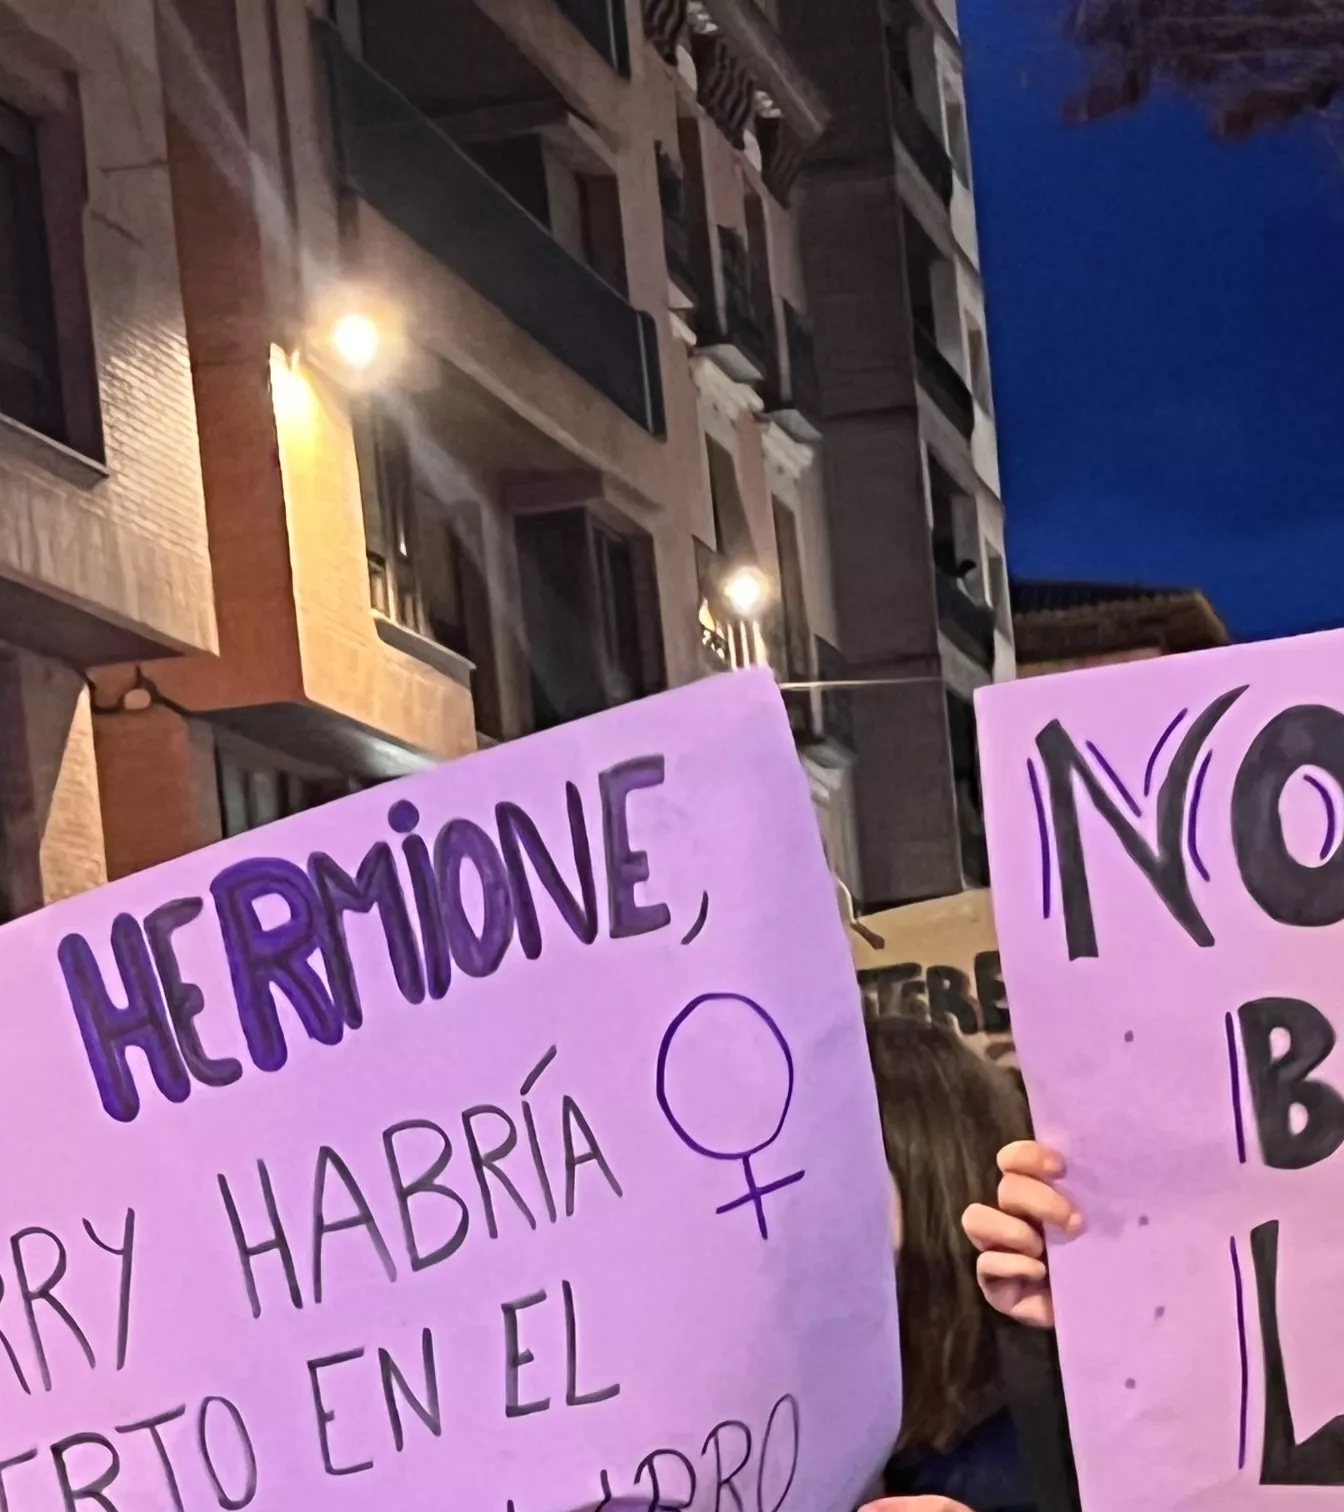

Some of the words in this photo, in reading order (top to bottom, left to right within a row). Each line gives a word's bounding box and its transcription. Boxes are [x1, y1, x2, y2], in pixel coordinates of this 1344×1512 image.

[216, 1044, 624, 1320] HABRÍA
[306, 1327, 442, 1477] EN
[502, 1280, 621, 1418] EL
